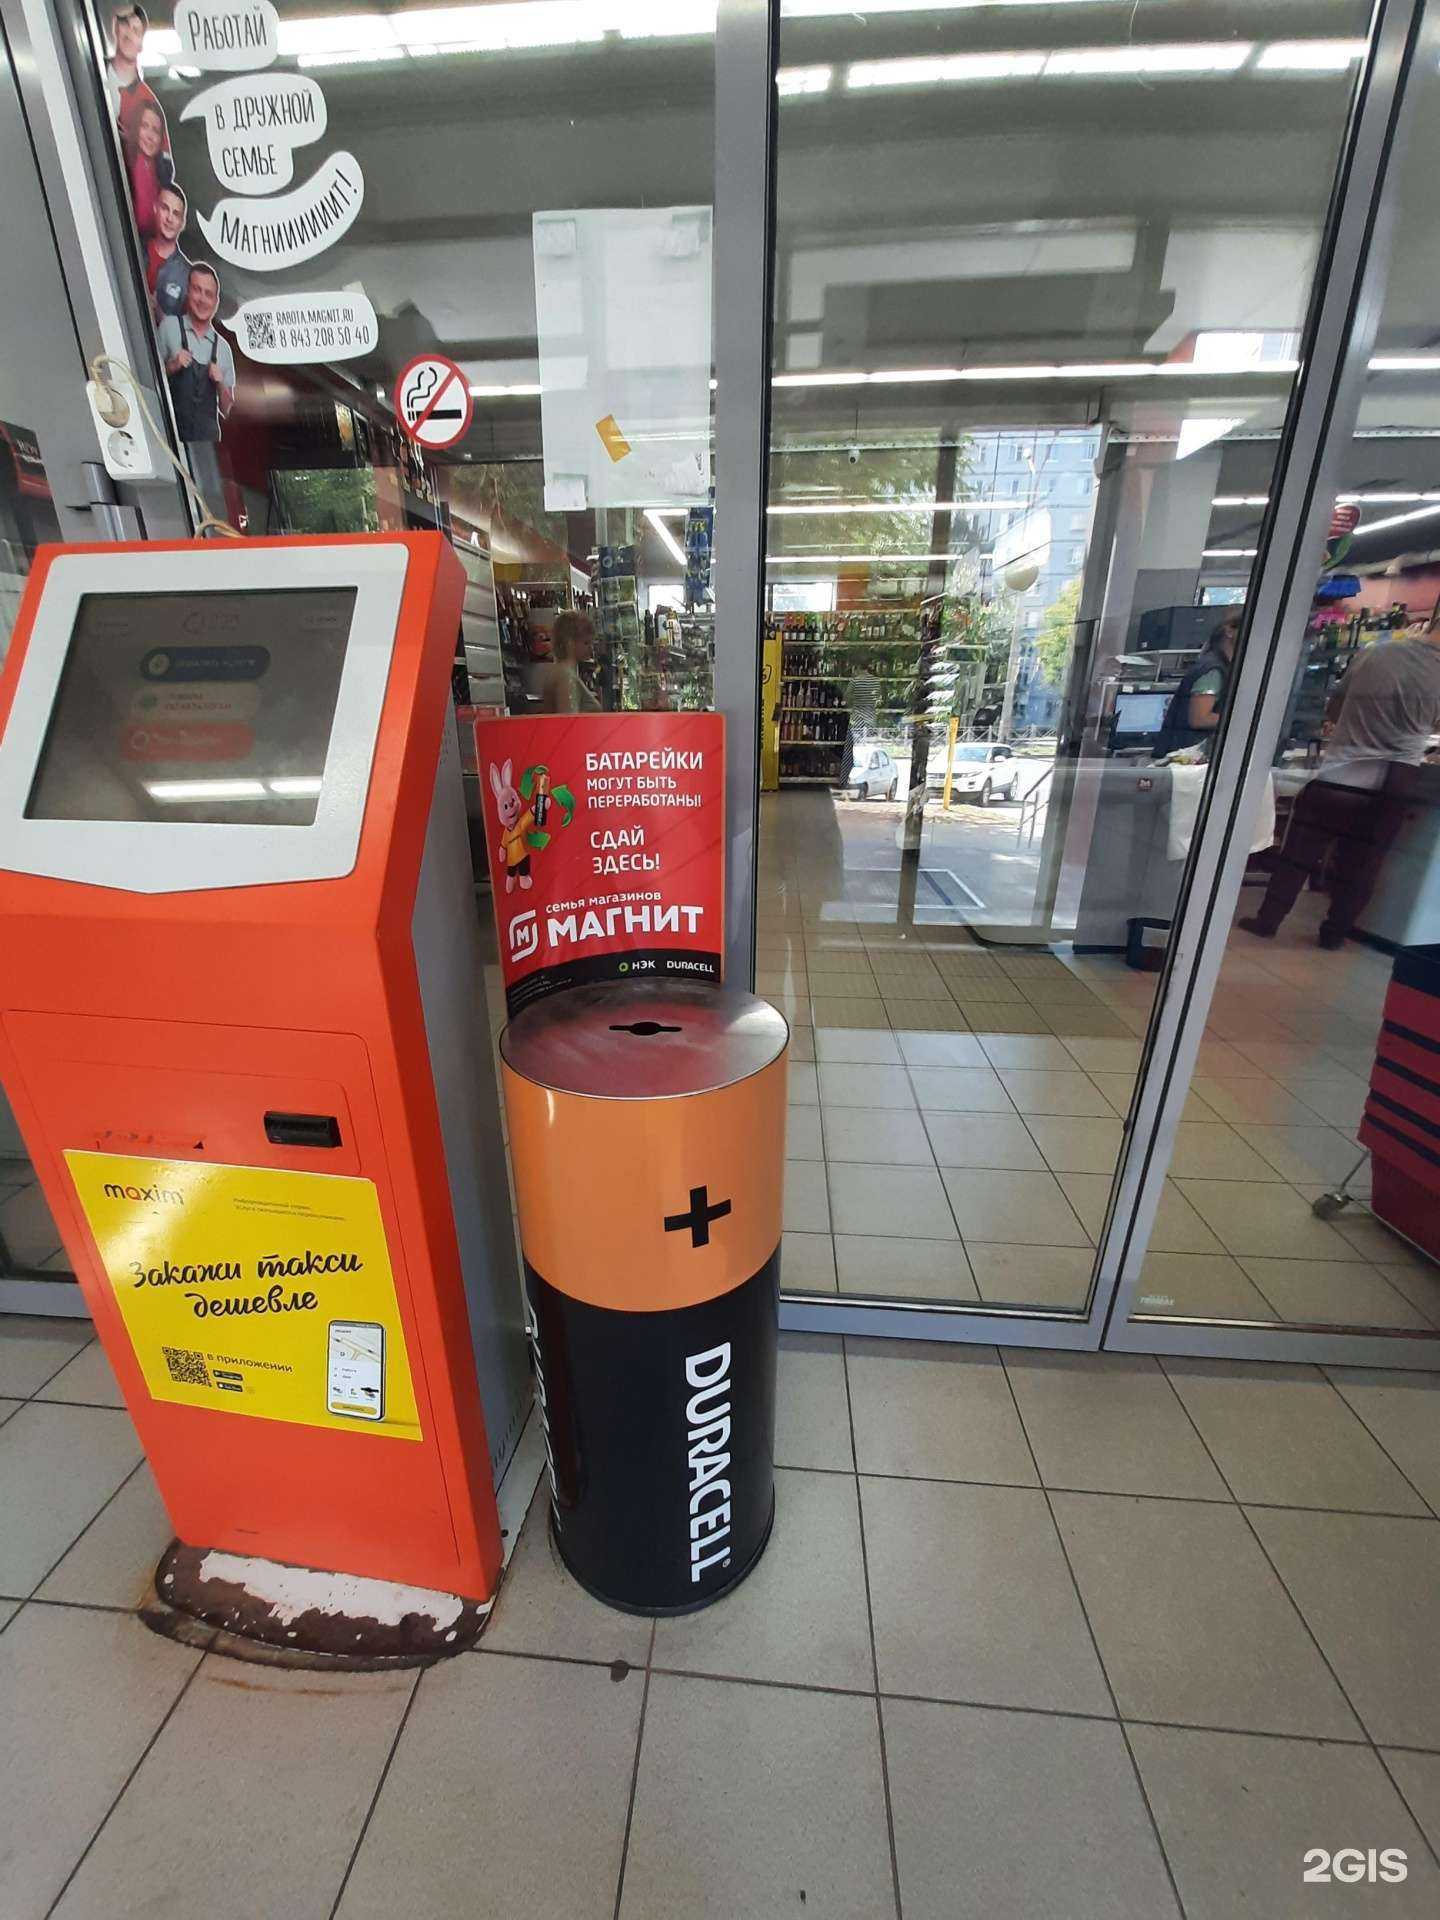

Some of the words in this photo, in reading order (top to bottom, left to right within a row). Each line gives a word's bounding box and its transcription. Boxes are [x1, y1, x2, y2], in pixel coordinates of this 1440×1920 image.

[188, 5, 267, 52] РАБОТАЙ
[233, 88, 315, 132] ДРУЖНОЙ
[222, 145, 278, 178] СЕМЬЕ
[280, 329, 287, 347] 8
[290, 327, 311, 347] 843
[314, 326, 335, 346] 208
[339, 326, 351, 345] 50
[355, 325, 370, 345] 40
[586, 747, 703, 771] БАТАРЕЙКИ
[587, 777, 633, 791] МОГУТ
[637, 776, 677, 789] БЫТЬ
[588, 794, 702, 809] ПЕРЕРАБОТАНЫ!
[590, 824, 645, 851] СДАЙ
[592, 853, 660, 876] ЗДЕСЬ!
[545, 900, 585, 914] семья
[589, 892, 662, 907] магазинов
[547, 905, 704, 947] МАГНИТ
[632, 960, 656, 970] НЭК
[666, 960, 714, 973] DURACELL
[104, 1183, 185, 1205] maxim
[130, 1260, 242, 1288] Закажи
[257, 1250, 363, 1279] такси
[184, 1284, 318, 1318] дешевле
[217, 1354, 293, 1372] приложении
[685, 1341, 731, 1583] DURACELL
